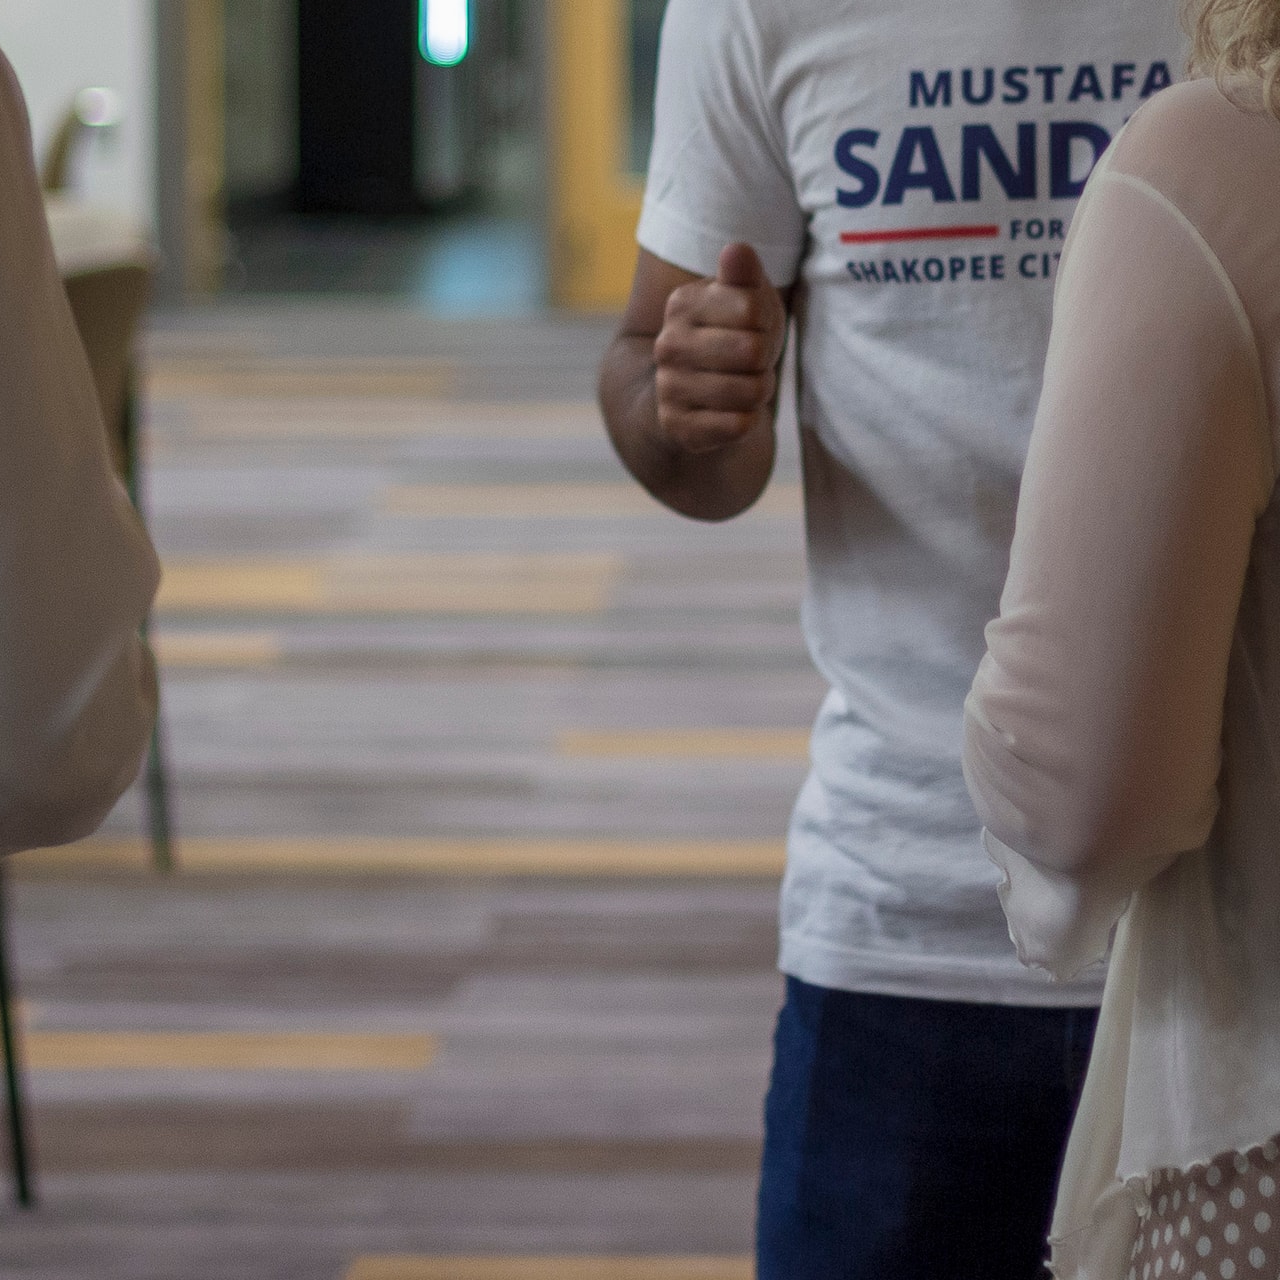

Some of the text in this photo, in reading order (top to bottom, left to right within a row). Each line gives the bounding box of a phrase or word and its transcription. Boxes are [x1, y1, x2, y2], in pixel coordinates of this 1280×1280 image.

[908, 61, 1172, 108] MUSTAFA
[833, 118, 1130, 209] SAND
[1010, 218, 1064, 240] FOR
[846, 254, 1005, 284] SHAKOPEE
